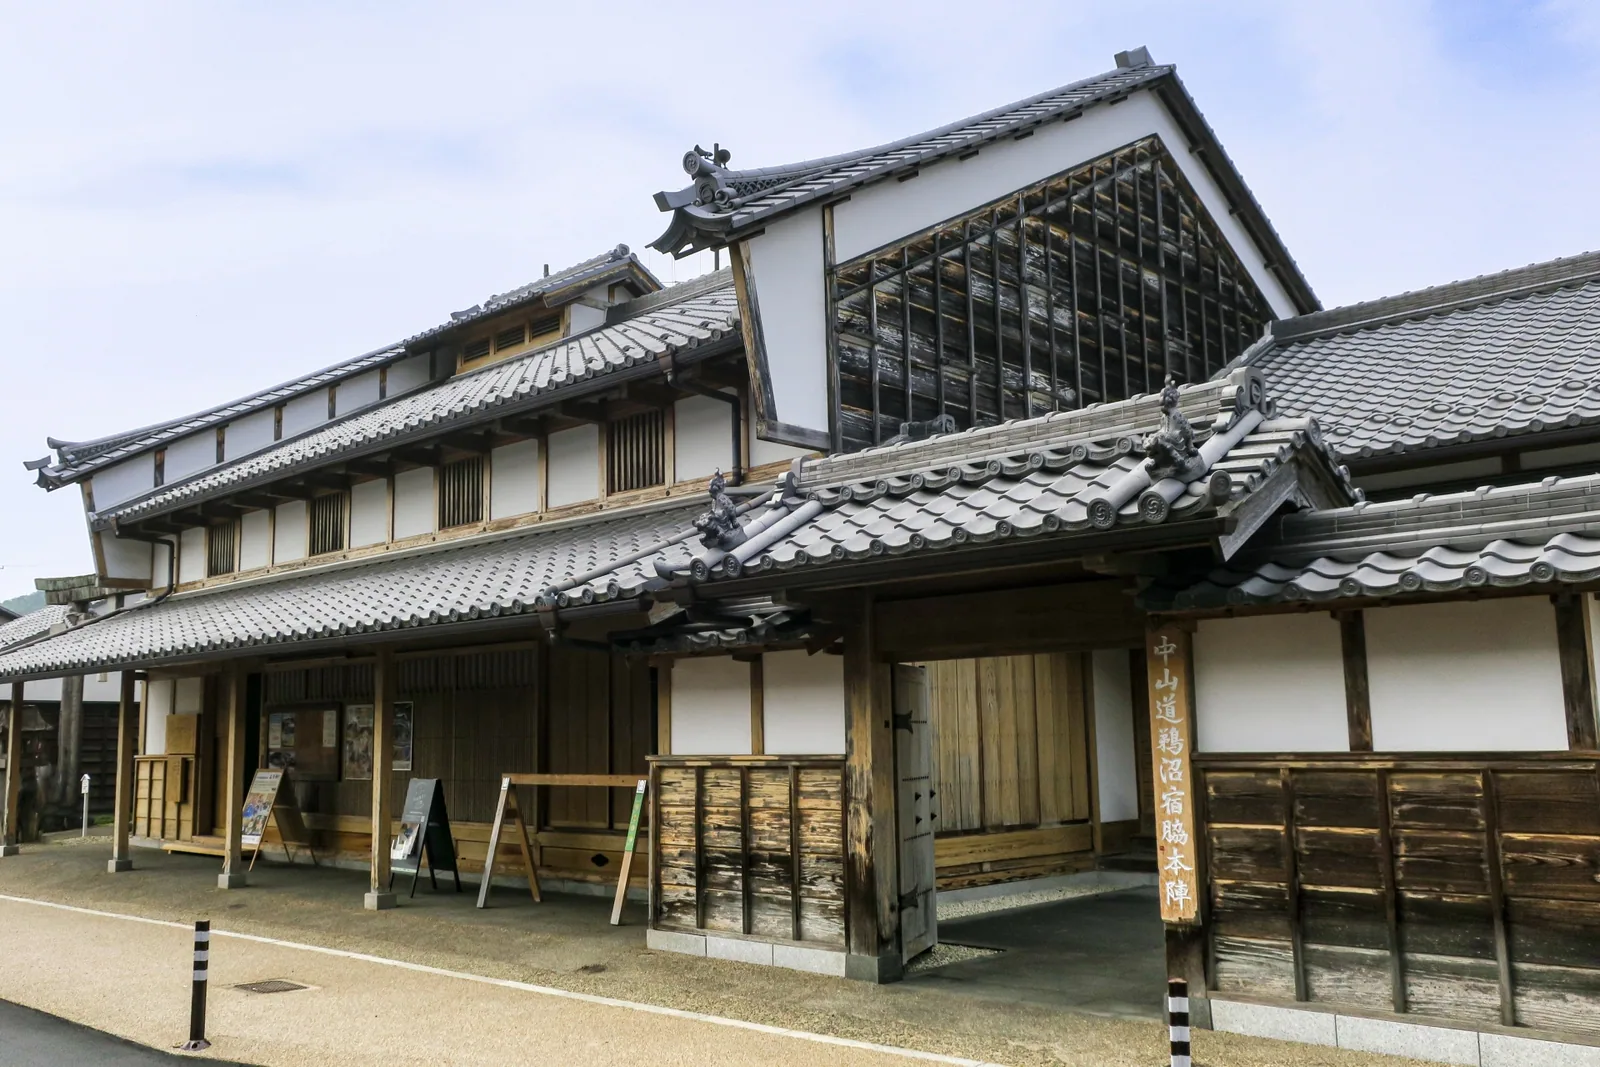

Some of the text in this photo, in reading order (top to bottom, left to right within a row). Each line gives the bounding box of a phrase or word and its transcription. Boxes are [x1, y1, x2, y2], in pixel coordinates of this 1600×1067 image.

[1153, 635, 1194, 911] 中山道鵜沼宿脇本陣
